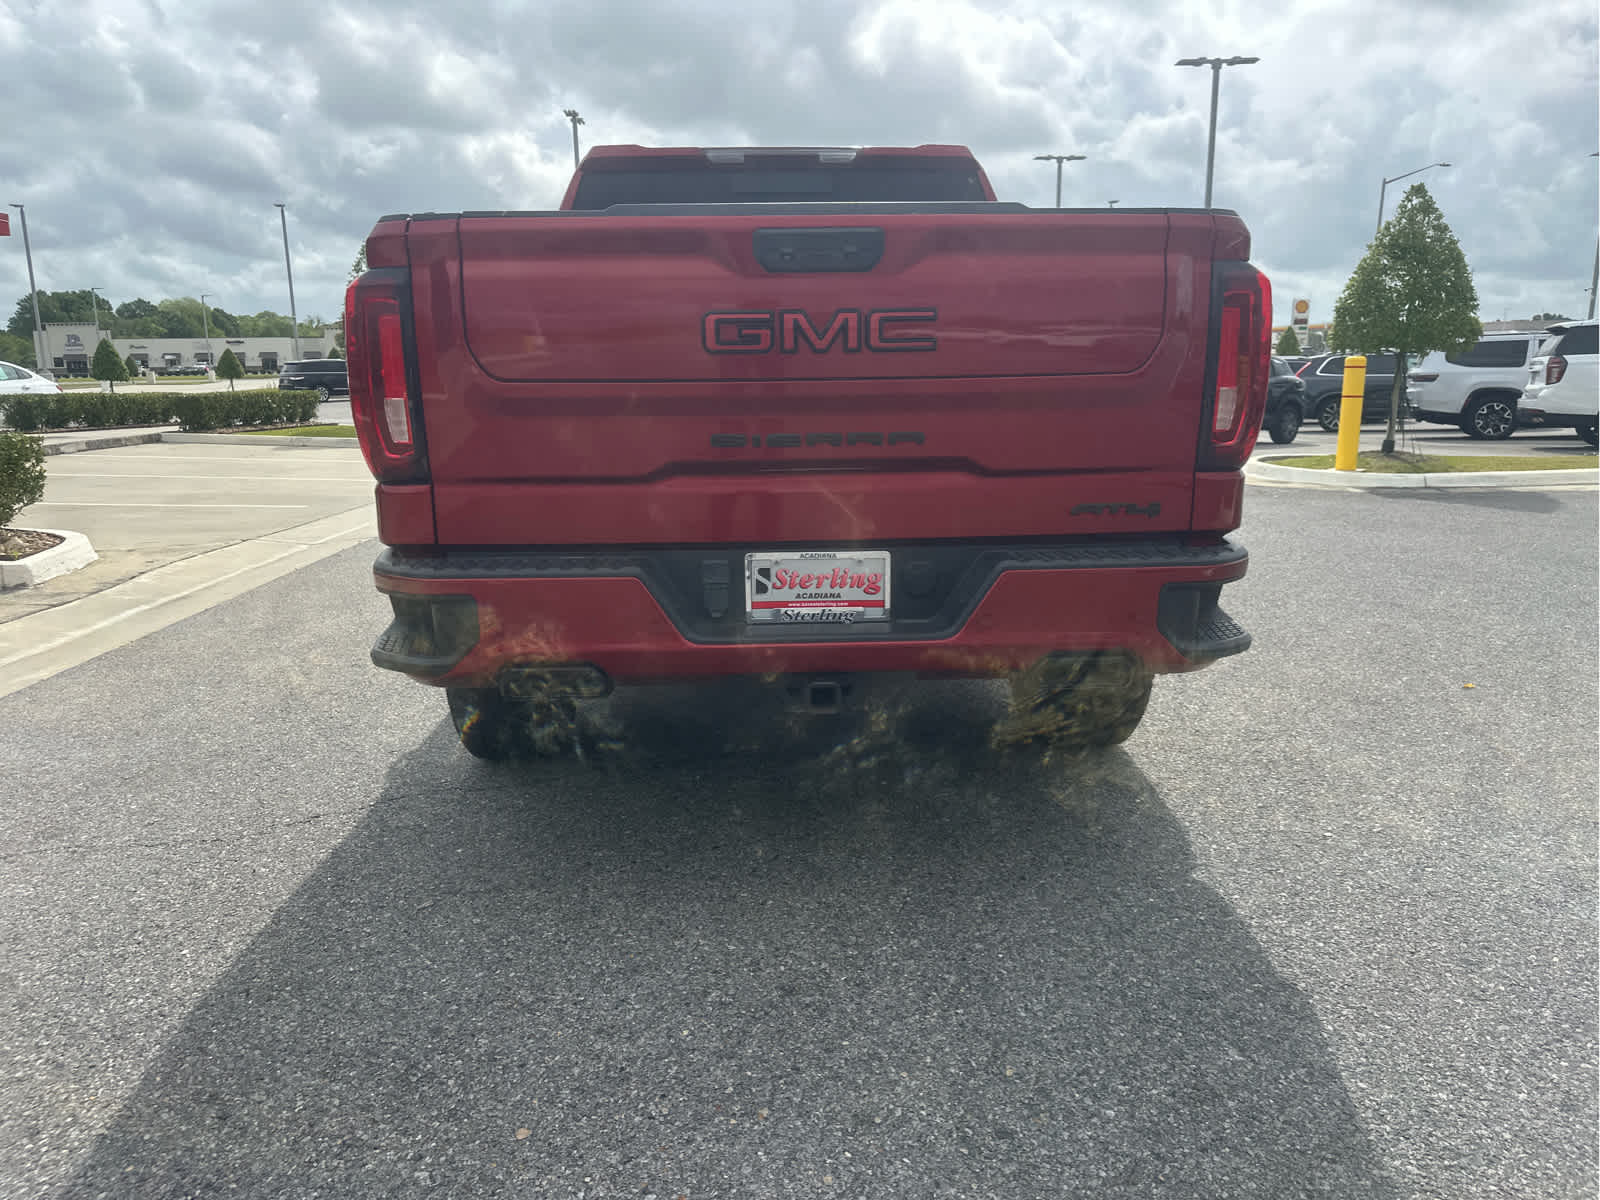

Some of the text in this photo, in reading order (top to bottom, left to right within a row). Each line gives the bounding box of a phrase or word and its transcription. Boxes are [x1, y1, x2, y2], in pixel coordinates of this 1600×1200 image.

[702, 307, 937, 355] GMC
[709, 431, 926, 448] SIERRA
[771, 567, 883, 596] Sterling
[794, 592, 842, 600] ACADIANA
[782, 608, 857, 625] Sterling
